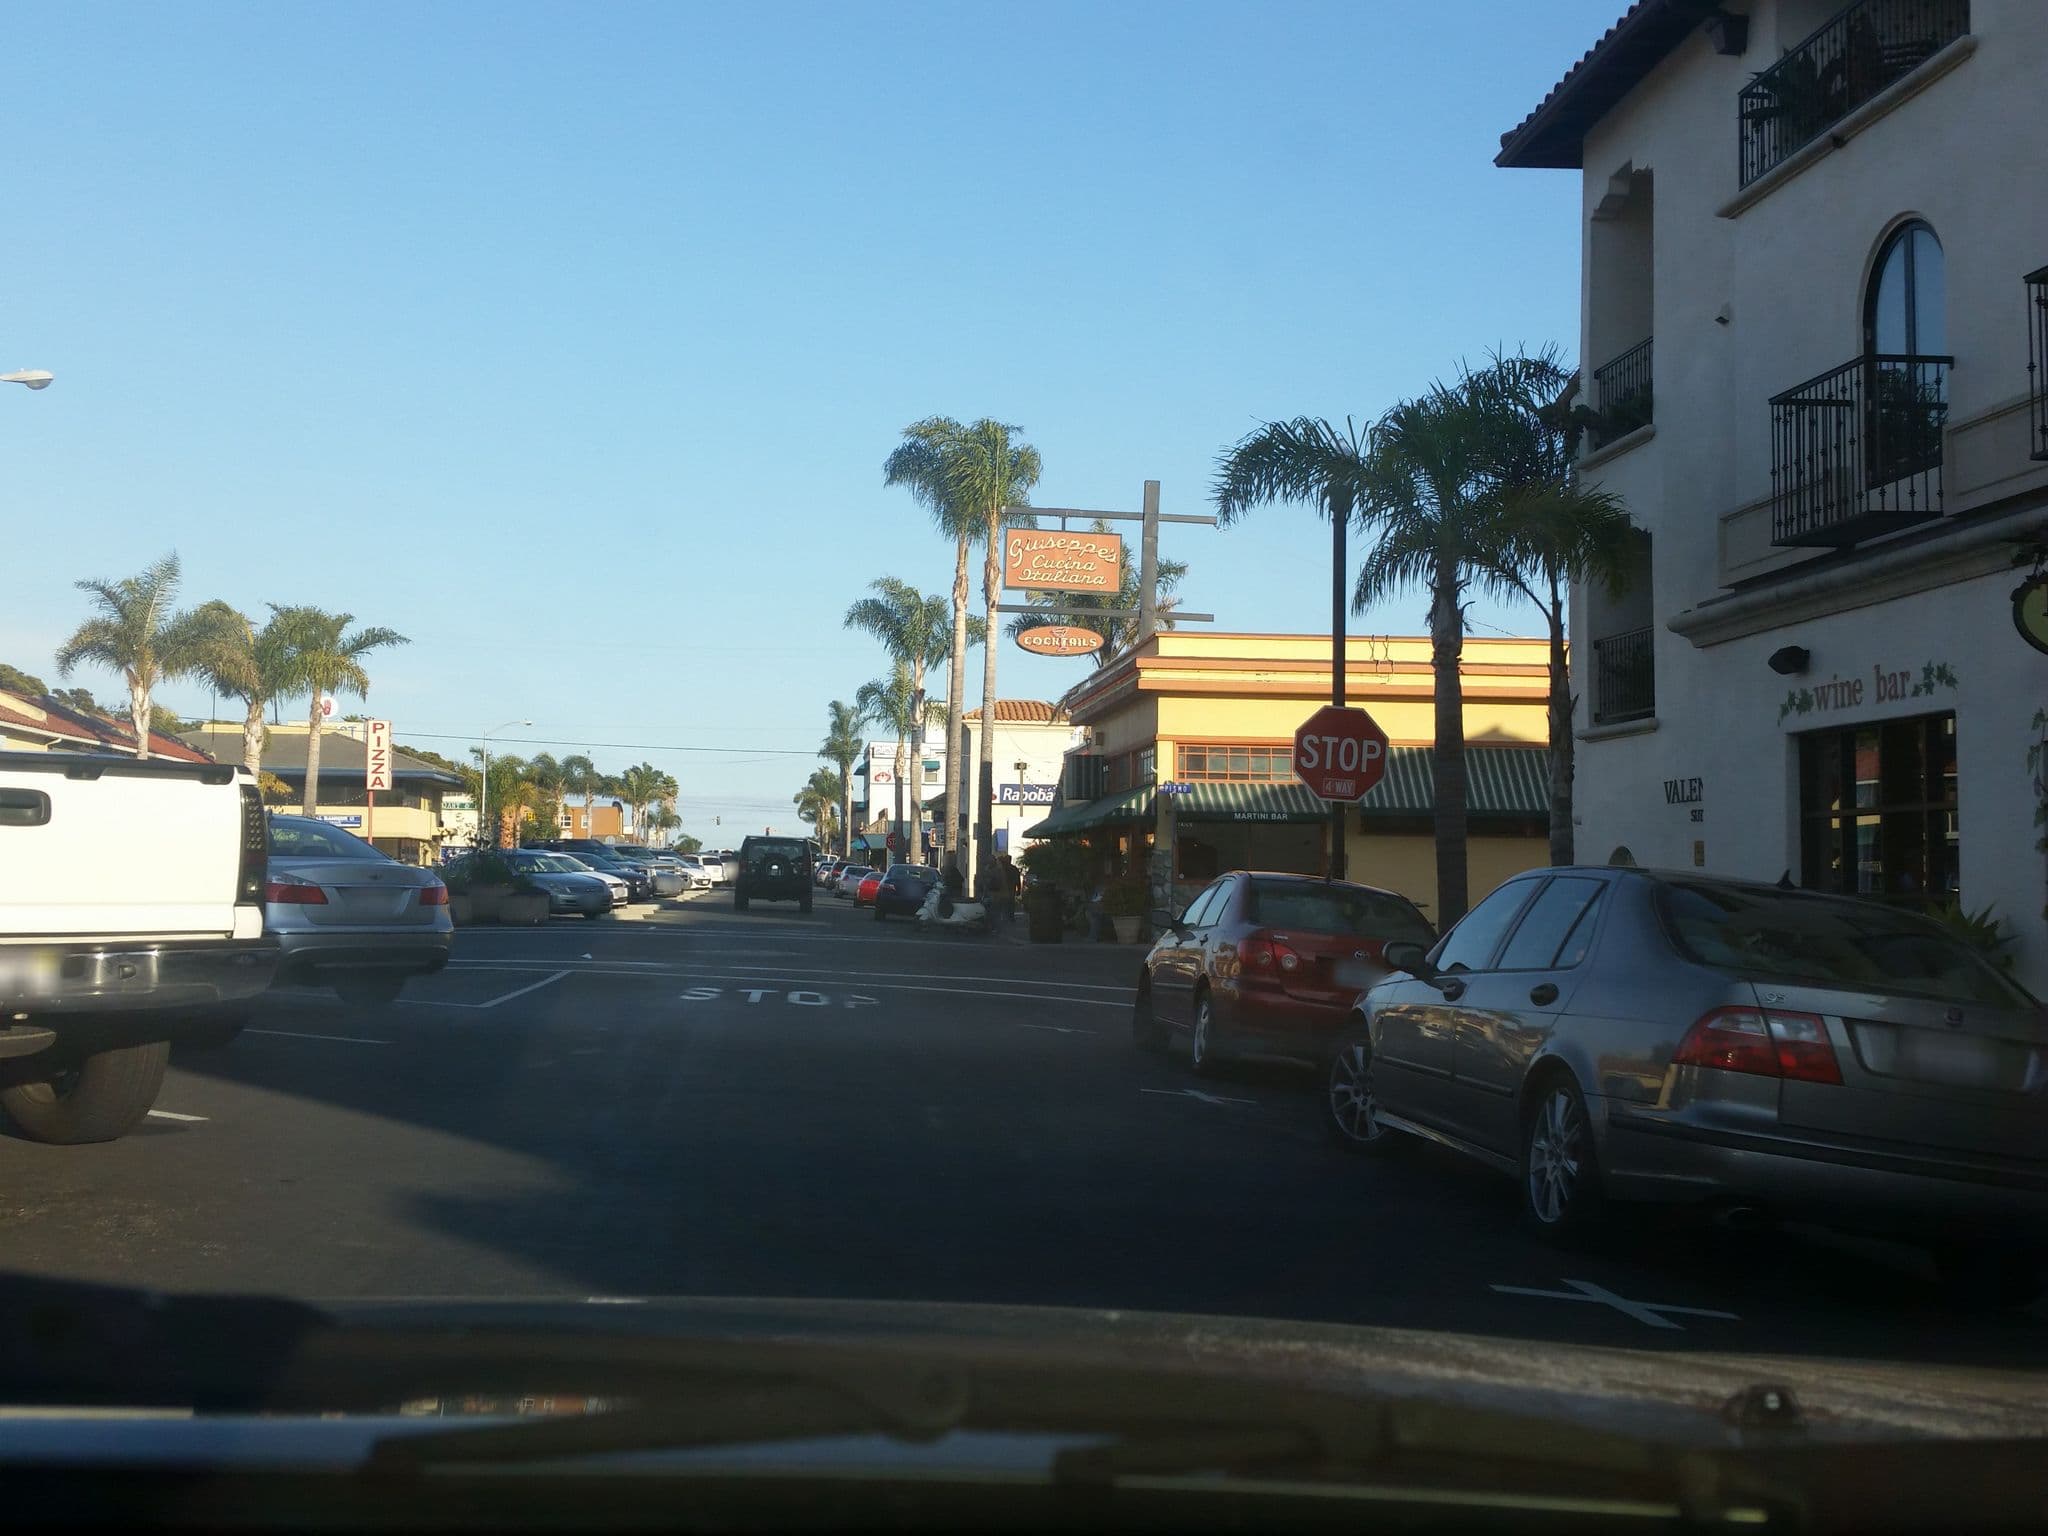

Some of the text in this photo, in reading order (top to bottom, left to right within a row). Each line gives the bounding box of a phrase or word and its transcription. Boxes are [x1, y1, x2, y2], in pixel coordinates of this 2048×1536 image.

[1010, 536, 1117, 568] Giuseppe's
[1032, 554, 1097, 571] Cucina
[1018, 568, 1107, 585] Italiana
[1024, 636, 1097, 647] COCKTAILS
[1814, 664, 1911, 712] wine bar
[371, 723, 385, 788] PIZZA
[1300, 734, 1382, 773] STOP
[1164, 785, 1188, 794] PISMO
[1234, 812, 1288, 821] MARTINI BAR
[680, 987, 881, 1008] STOP
